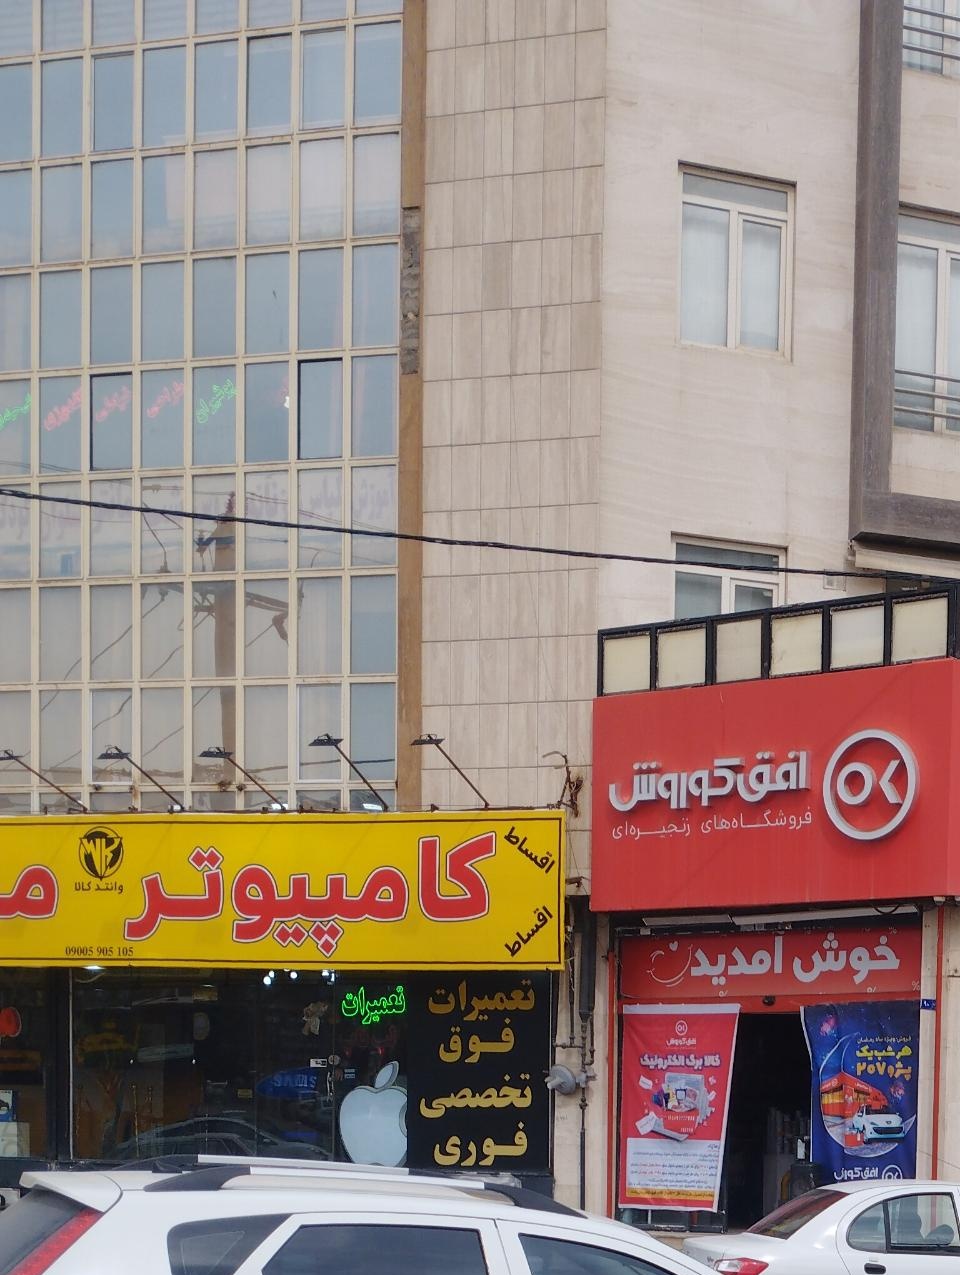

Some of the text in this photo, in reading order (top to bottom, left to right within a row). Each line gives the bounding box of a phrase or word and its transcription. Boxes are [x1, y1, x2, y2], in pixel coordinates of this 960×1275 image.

[608, 750, 810, 812] افق کوروش
[504, 826, 555, 874] اقساط
[74, 881, 92, 892] کالا
[123, 830, 497, 958] کامپیوتر
[504, 906, 554, 957] اقساط
[792, 932, 901, 985] خوش
[341, 985, 406, 1025] تعمیرات
[428, 978, 535, 1021] تعمیرات
[439, 1017, 515, 1063] فوق
[855, 1044, 912, 1061] هر شب یک
[856, 1061, 912, 1081] پژو ۲۰۷
[419, 1073, 533, 1119] تخصصی
[434, 1121, 528, 1166] فوری
